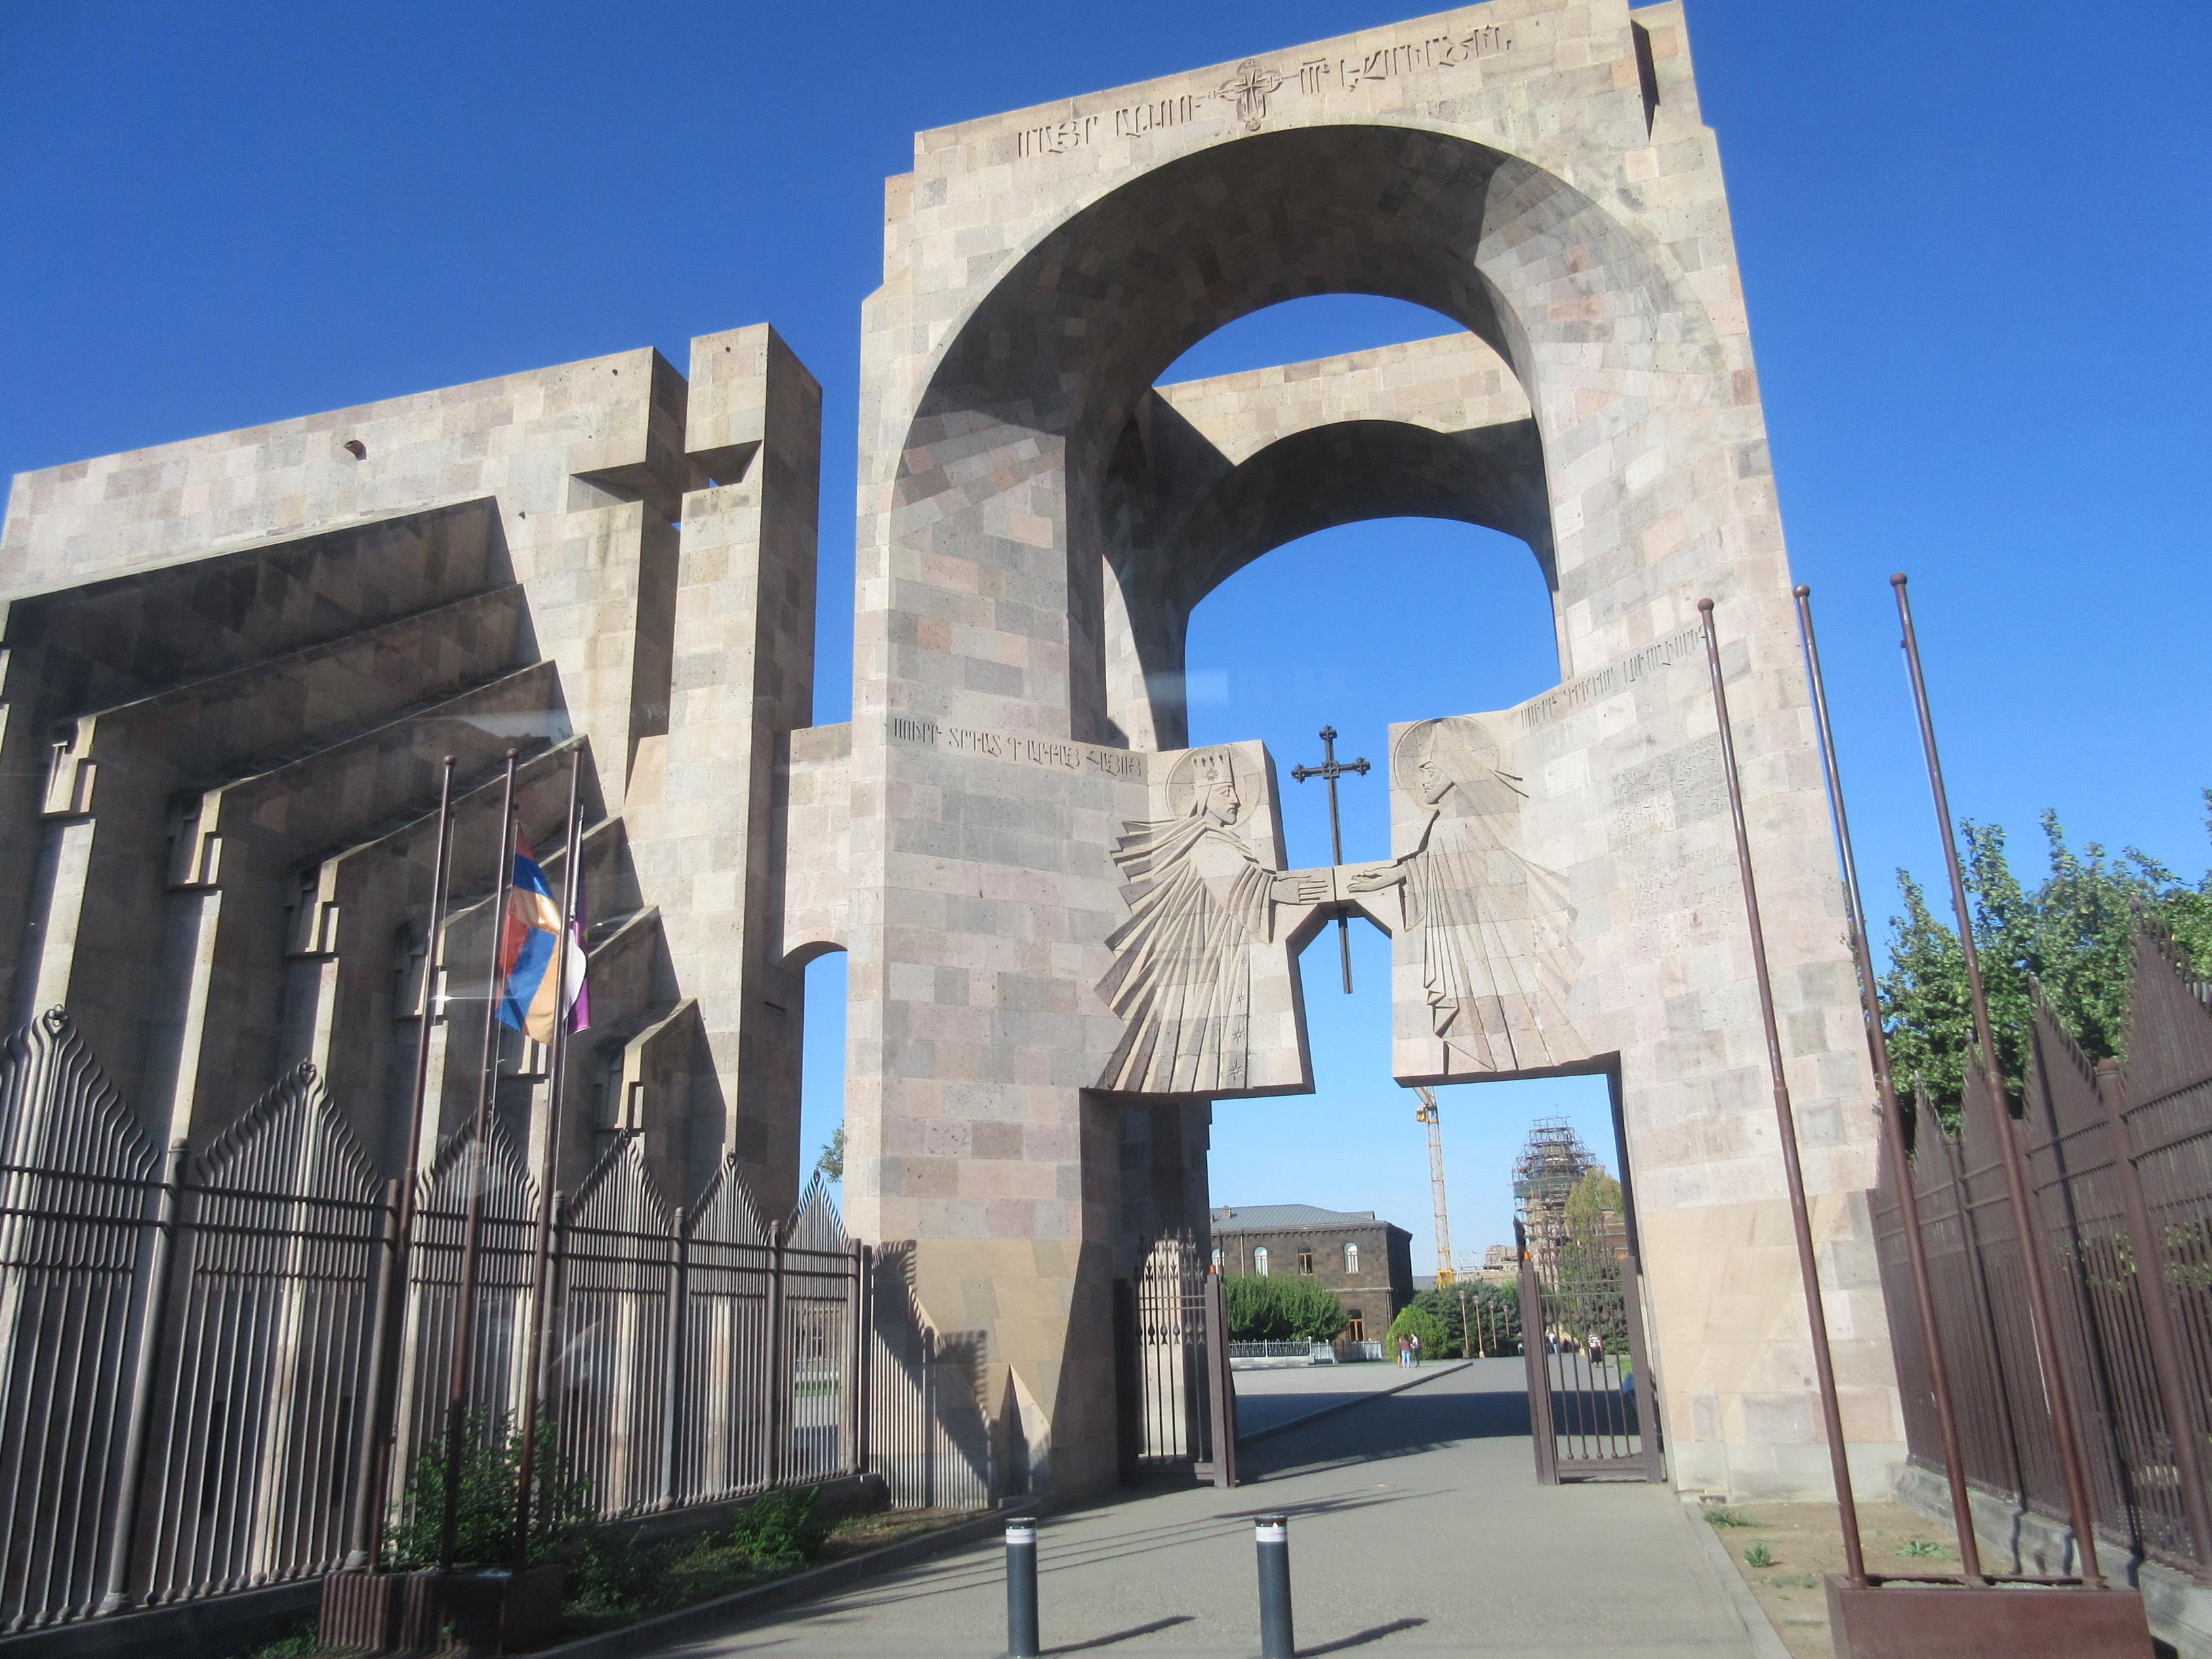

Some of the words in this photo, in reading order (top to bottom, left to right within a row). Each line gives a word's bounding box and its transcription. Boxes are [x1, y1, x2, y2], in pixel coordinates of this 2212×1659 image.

[1018, 115, 1098, 158] ՄԱՅՐ
[895, 718, 942, 744] ՍՈՒՐԲ
[949, 728, 1002, 758] ՏՐԴԱՏ
